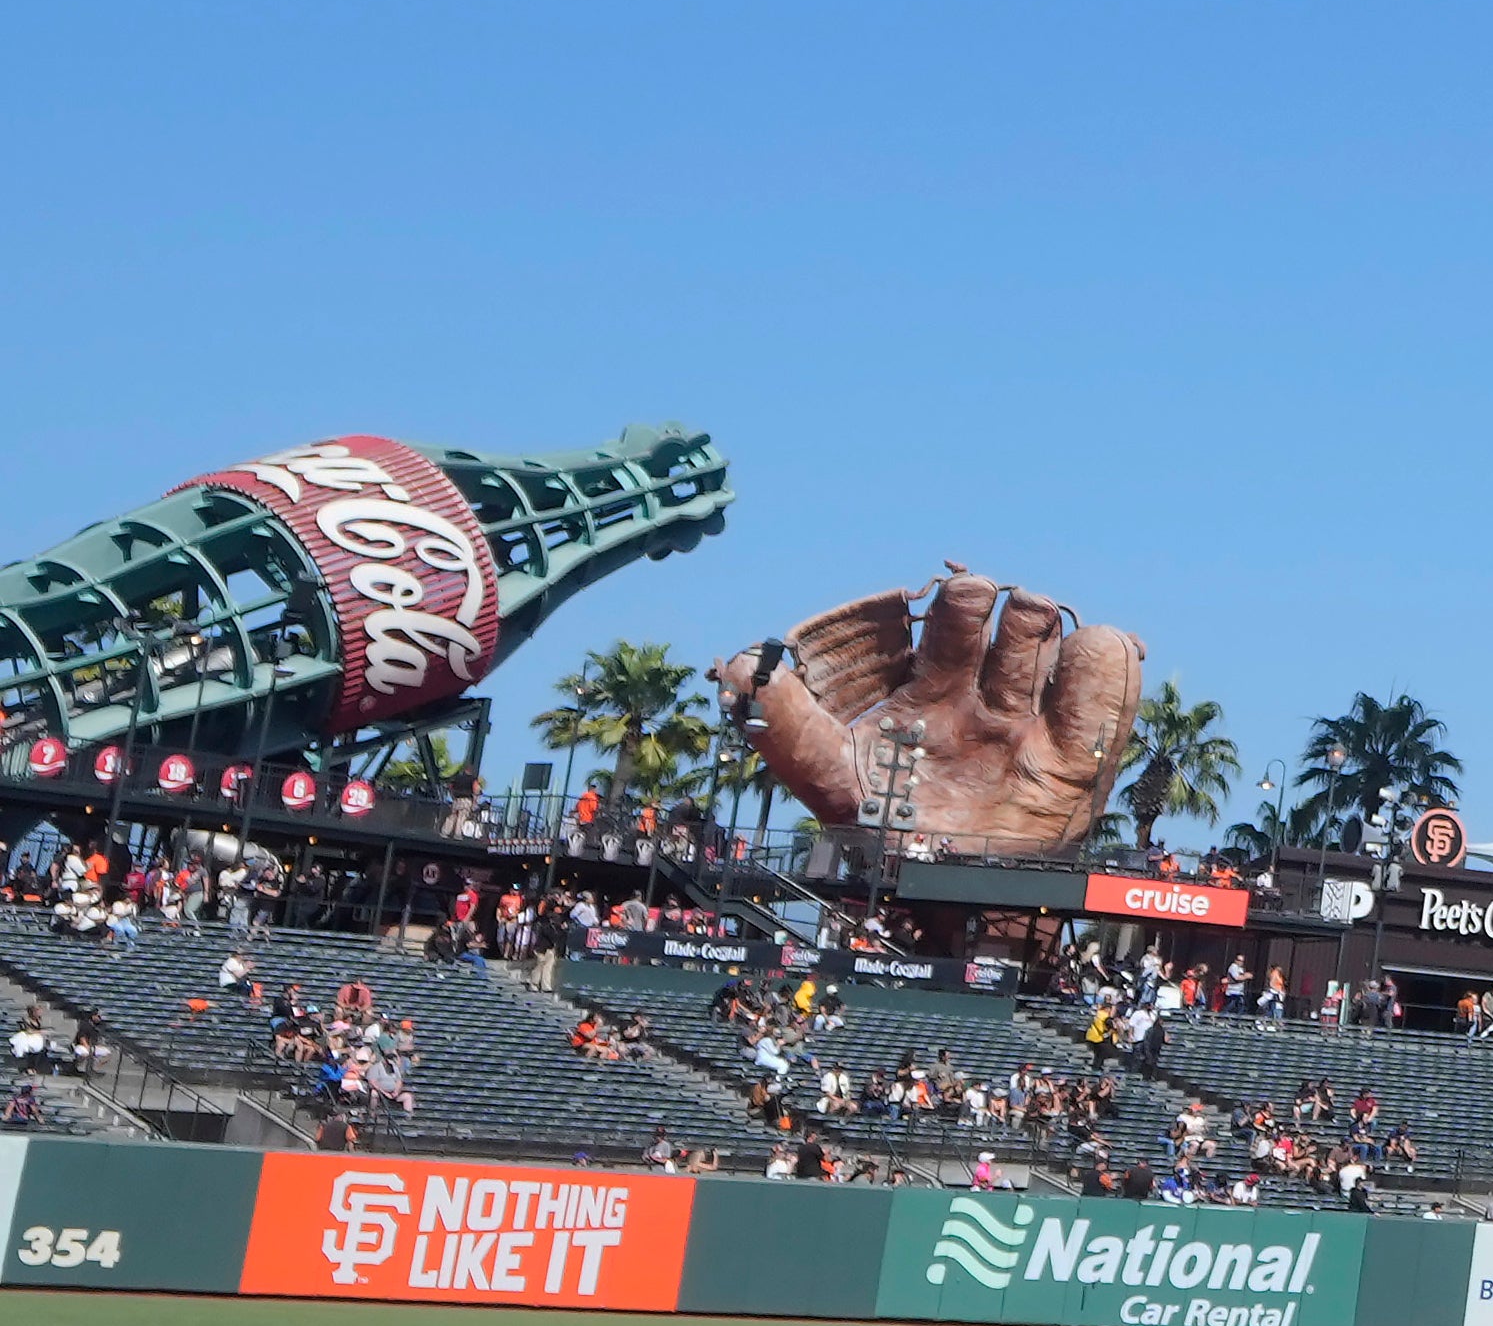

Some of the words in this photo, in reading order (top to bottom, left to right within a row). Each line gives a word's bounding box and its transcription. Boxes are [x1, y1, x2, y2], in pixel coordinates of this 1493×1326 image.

[1124, 884, 1210, 917] cruise
[1420, 887, 1482, 936] Peet's
[418, 1175, 628, 1230] NOTHING
[18, 1226, 120, 1269] 354
[408, 1231, 534, 1293] LIKE
[544, 1229, 621, 1297] IT
[1024, 1216, 1321, 1294] National
[1120, 1295, 1181, 1326] Car
